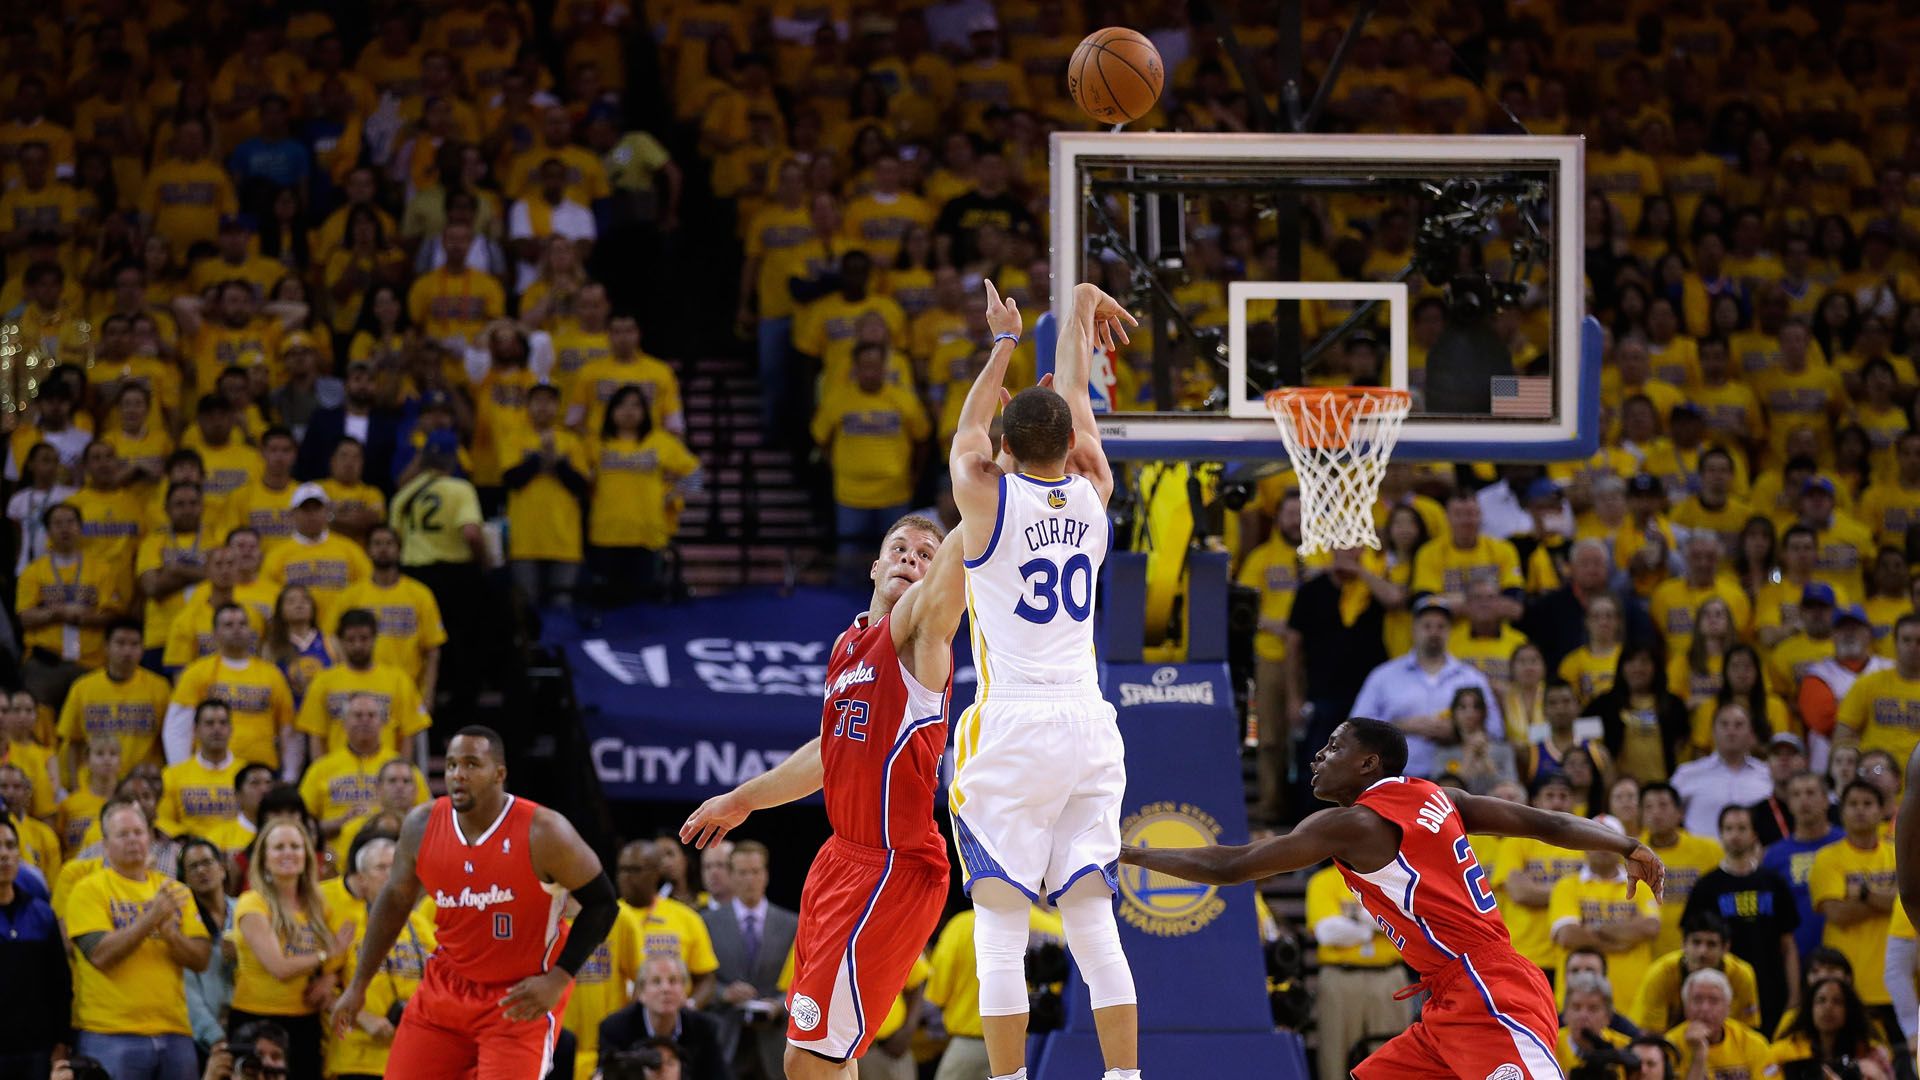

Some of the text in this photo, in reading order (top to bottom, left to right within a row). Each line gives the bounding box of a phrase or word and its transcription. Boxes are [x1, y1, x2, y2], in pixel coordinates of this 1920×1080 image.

[1024, 517, 1090, 552] CURRY
[1014, 553, 1092, 625] 30
[684, 637, 826, 662] CITY
[831, 660, 875, 693] Angeles
[1119, 681, 1215, 707] SPALDING
[833, 699, 870, 742] 32
[591, 737, 690, 785] CITY
[1121, 800, 1223, 835] OLDEN STATE
[1452, 834, 1497, 914] 2
[435, 884, 515, 911] Los Angeles
[493, 912, 513, 940] 0
[1119, 896, 1226, 936] WARRIORS
[1376, 914, 1407, 952] 2
